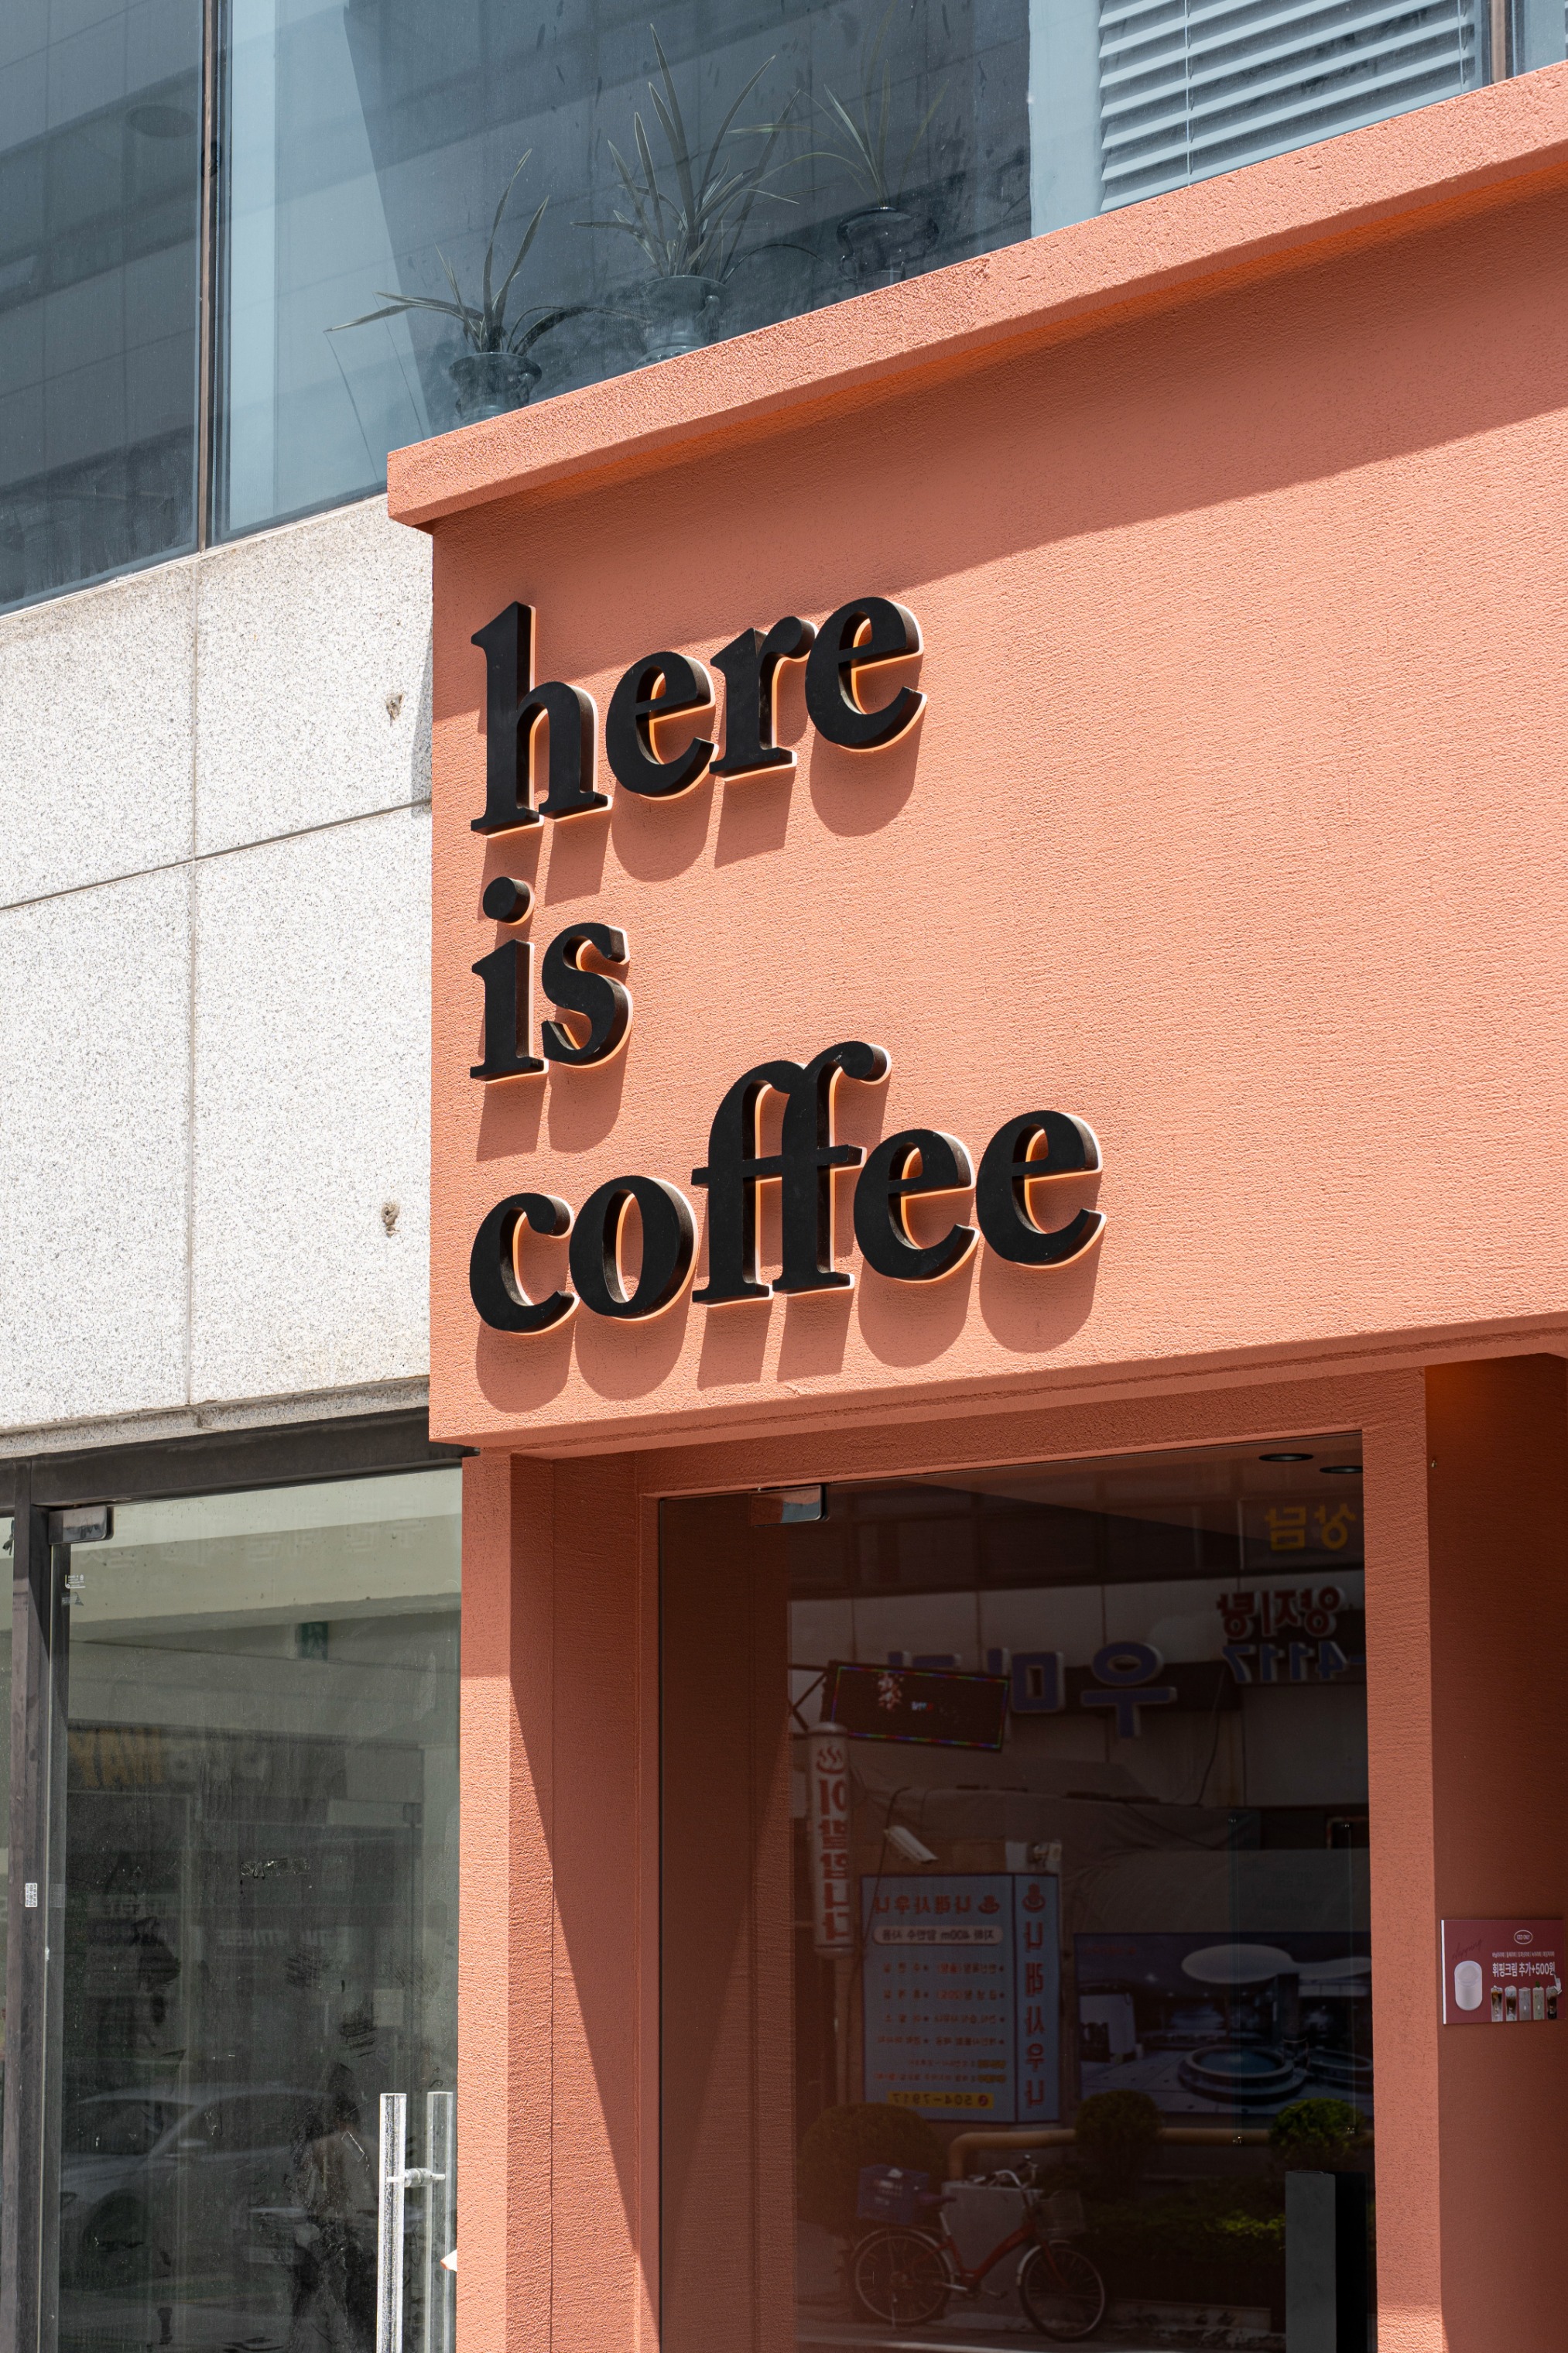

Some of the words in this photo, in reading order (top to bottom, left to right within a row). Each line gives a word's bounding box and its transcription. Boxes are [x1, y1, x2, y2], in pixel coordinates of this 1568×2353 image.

[471, 596, 926, 834] here
[470, 876, 632, 1081] is
[470, 1040, 1106, 1334] coffee
[1492, 1962, 1518, 1978] 휘핑크림
[1518, 1961, 1556, 1977] 추가+500원
